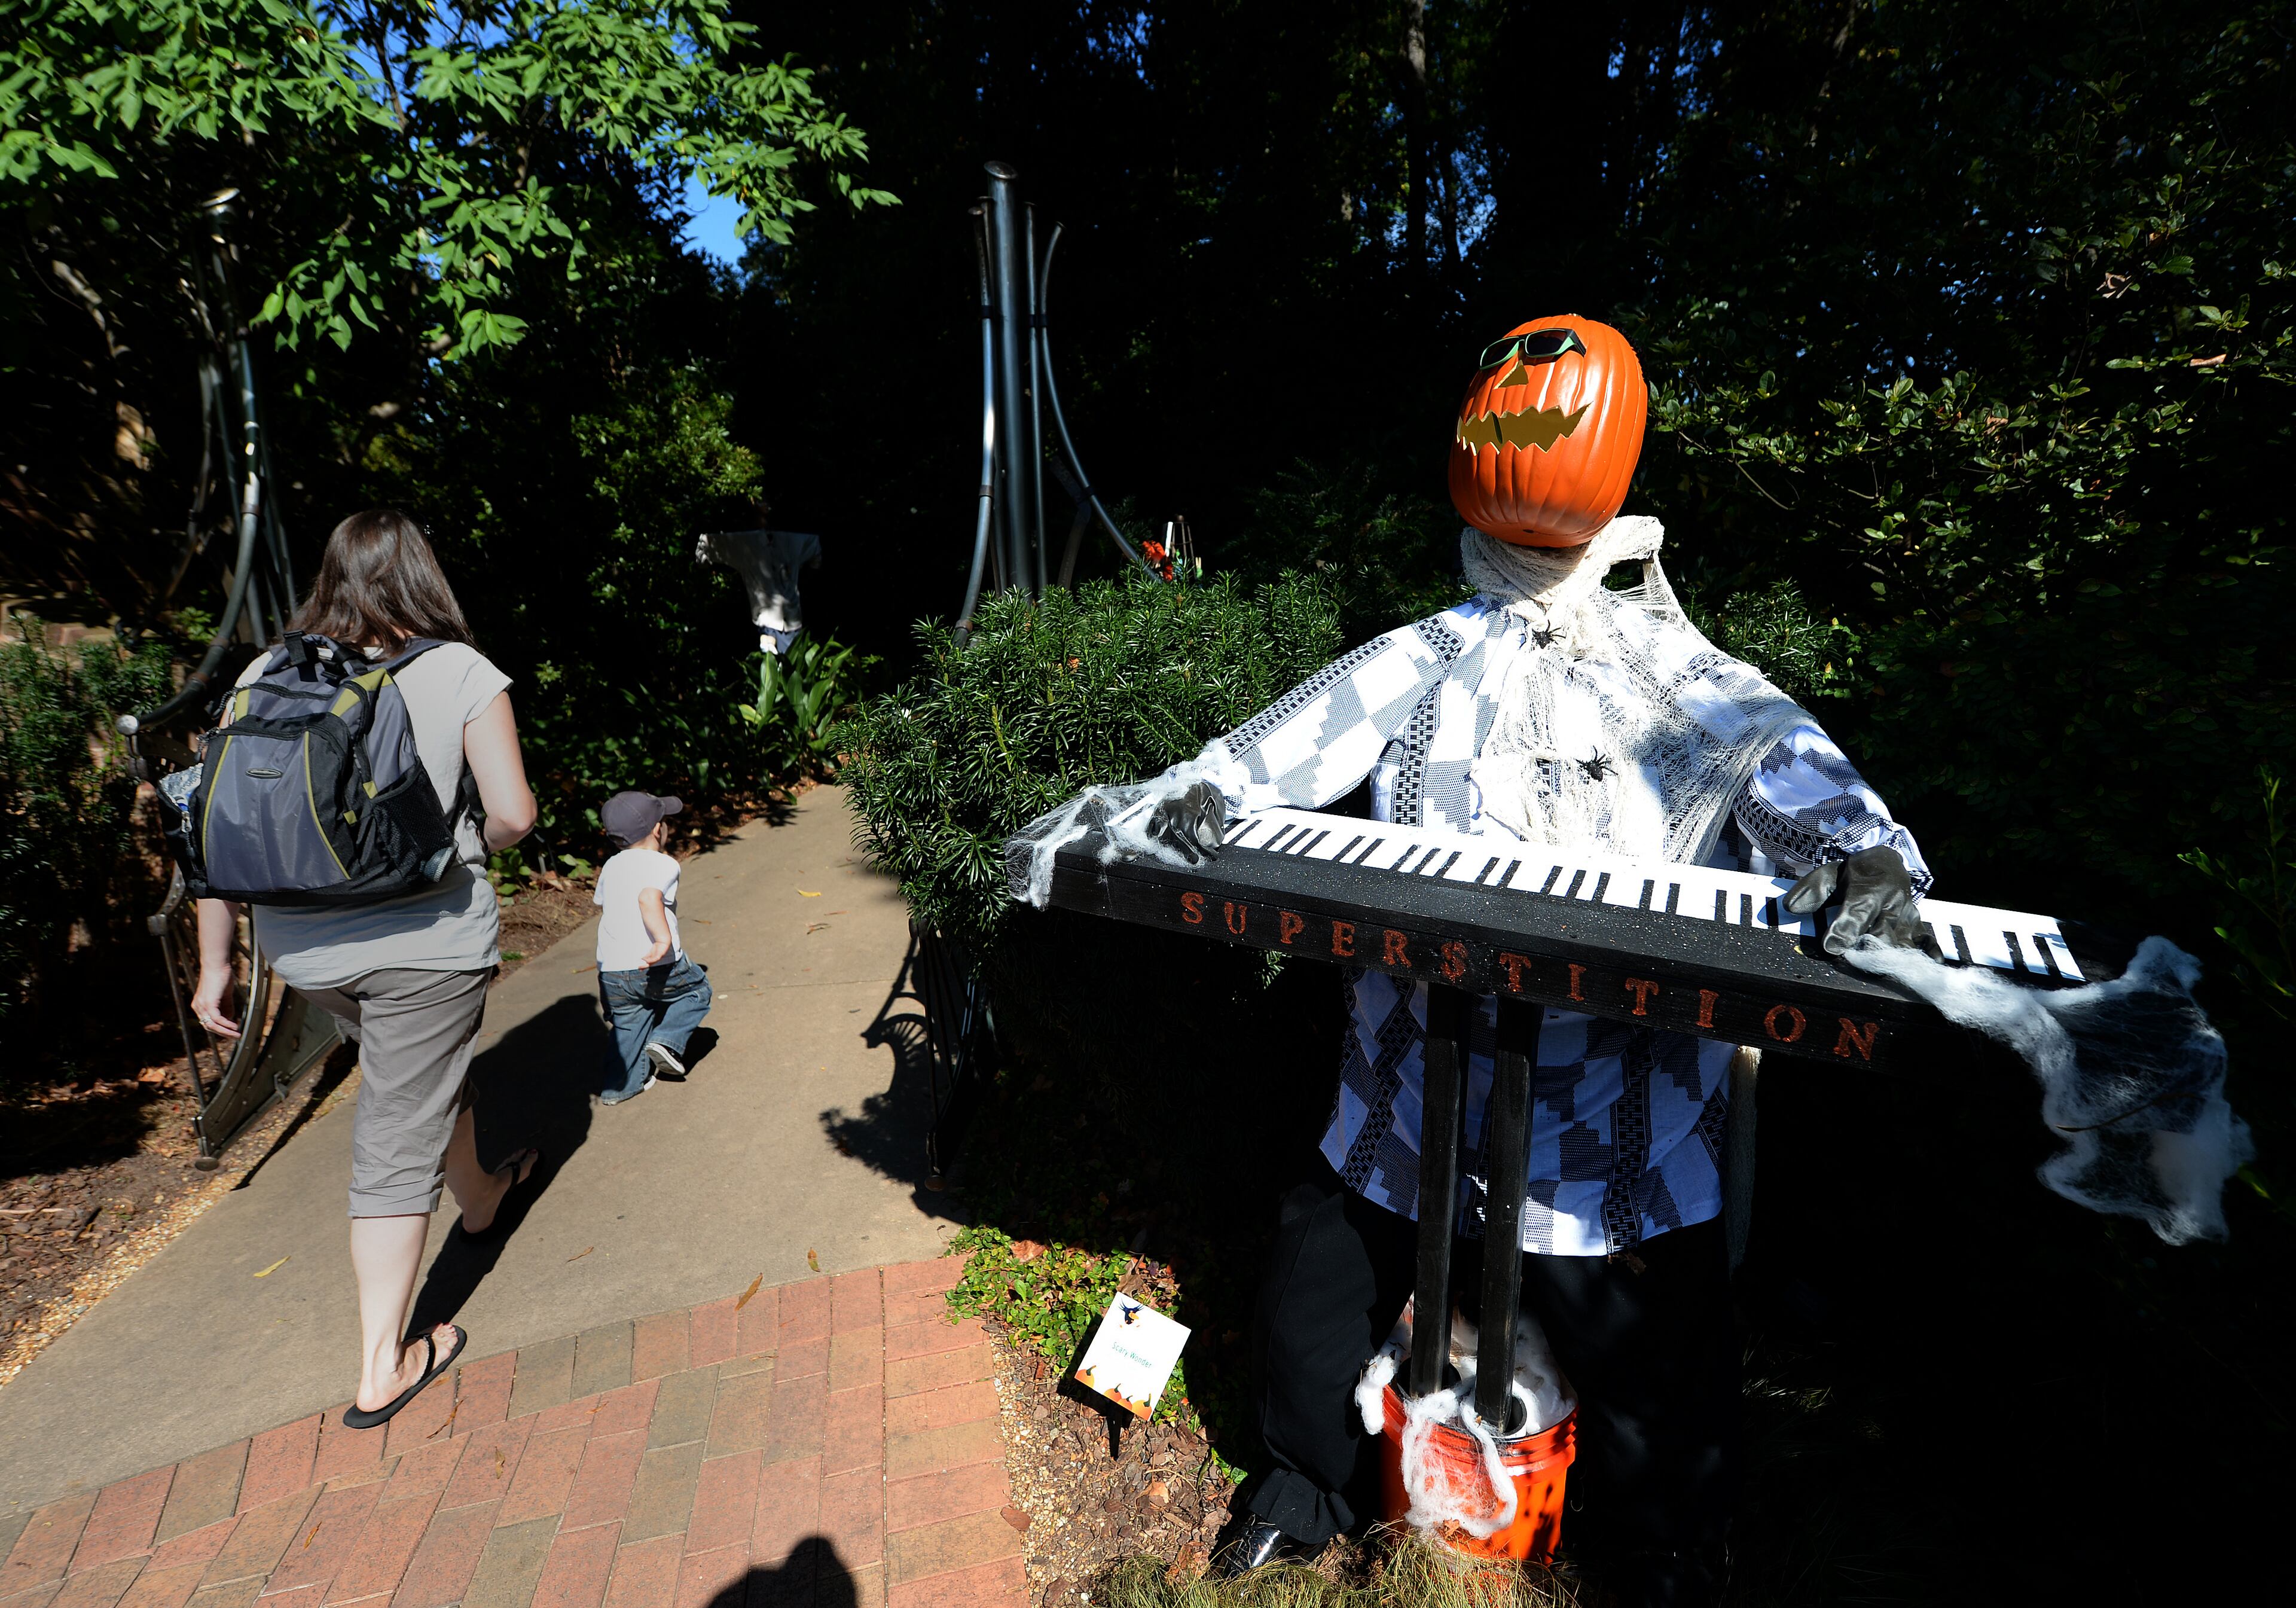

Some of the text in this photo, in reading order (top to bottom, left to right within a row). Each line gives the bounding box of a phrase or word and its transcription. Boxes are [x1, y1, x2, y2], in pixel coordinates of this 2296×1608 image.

[1181, 892, 1880, 1061] SUPERSTITION
[1112, 1341, 1152, 1368] Scary Wonder
